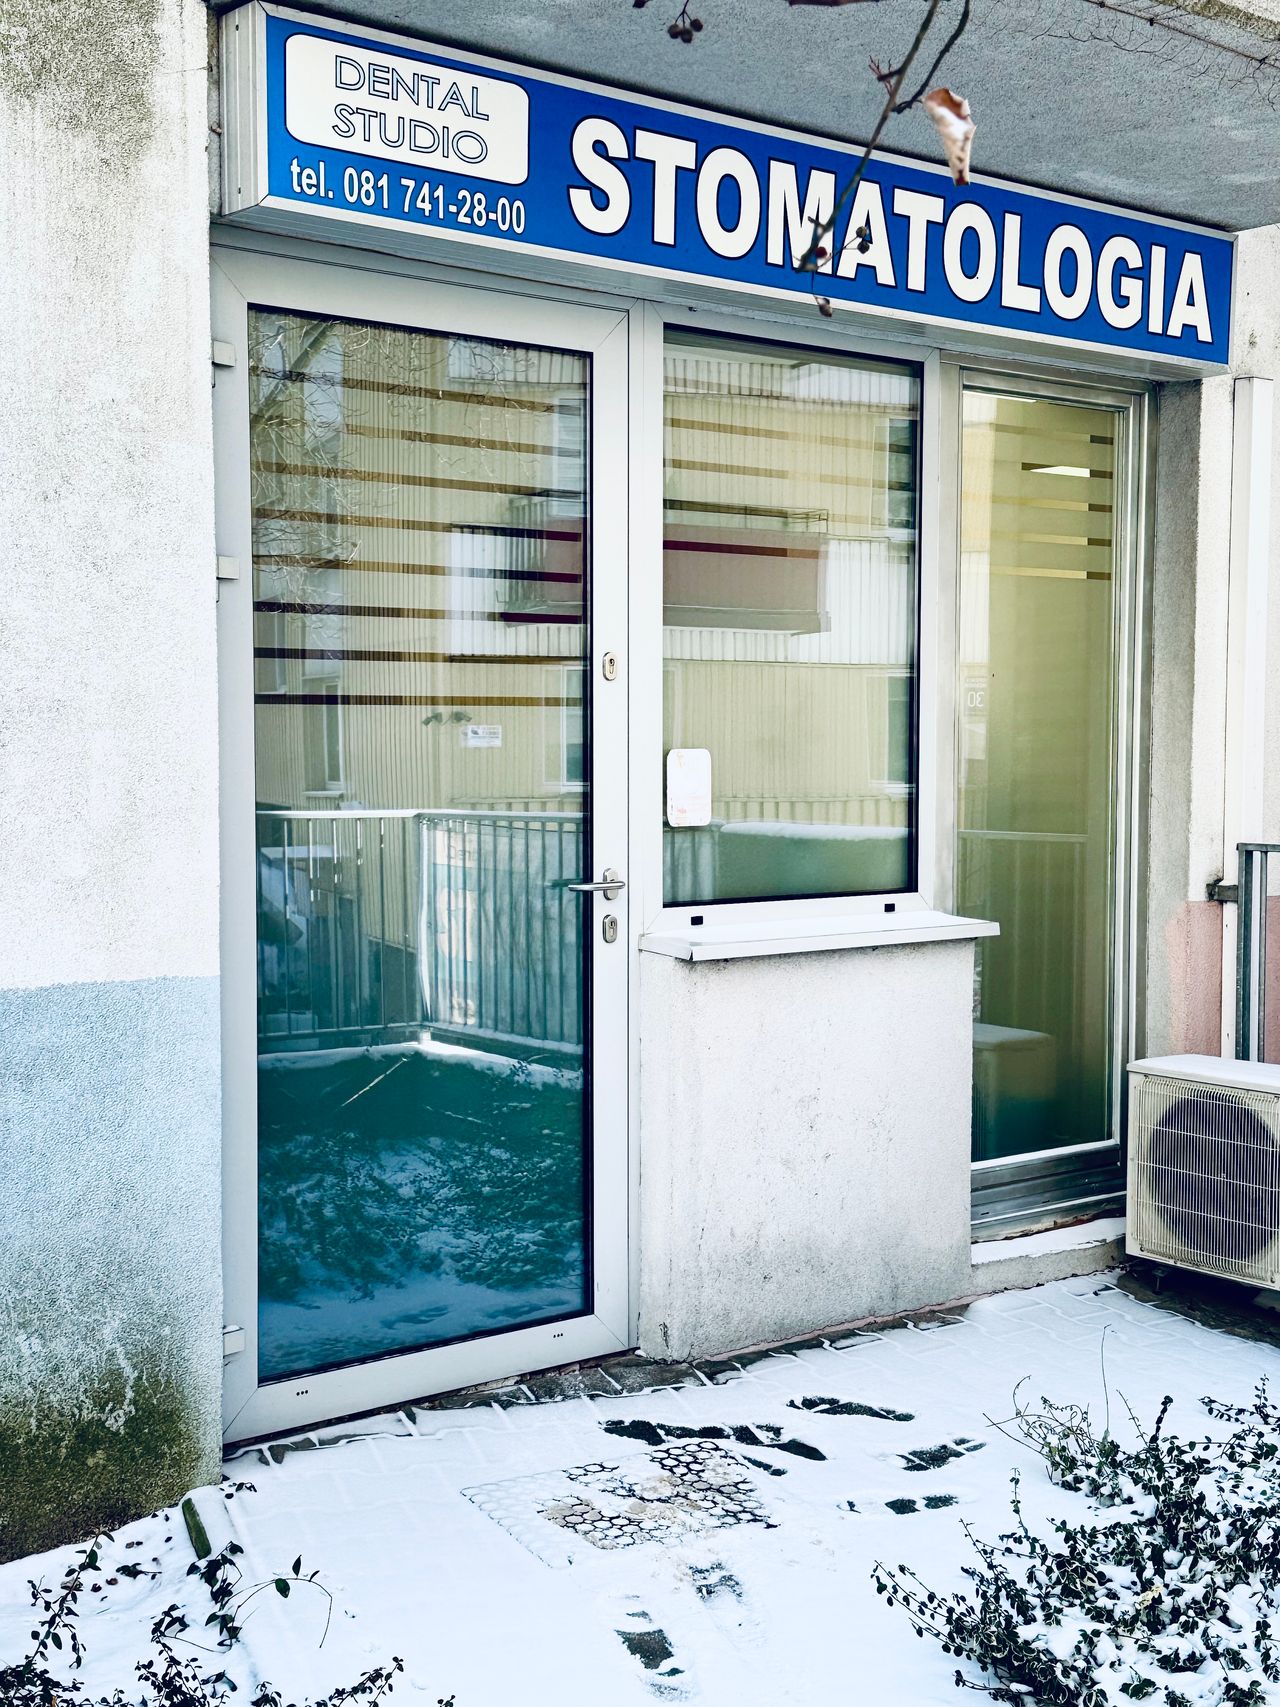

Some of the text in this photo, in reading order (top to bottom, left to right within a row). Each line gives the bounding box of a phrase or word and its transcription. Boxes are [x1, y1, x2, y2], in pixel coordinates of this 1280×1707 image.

[334, 55, 490, 121] DENTAL
[332, 103, 488, 164] STUDIO
[290, 157, 526, 235] tel. 081 741-28-00
[567, 116, 1216, 344] STOMATOLOGIA
